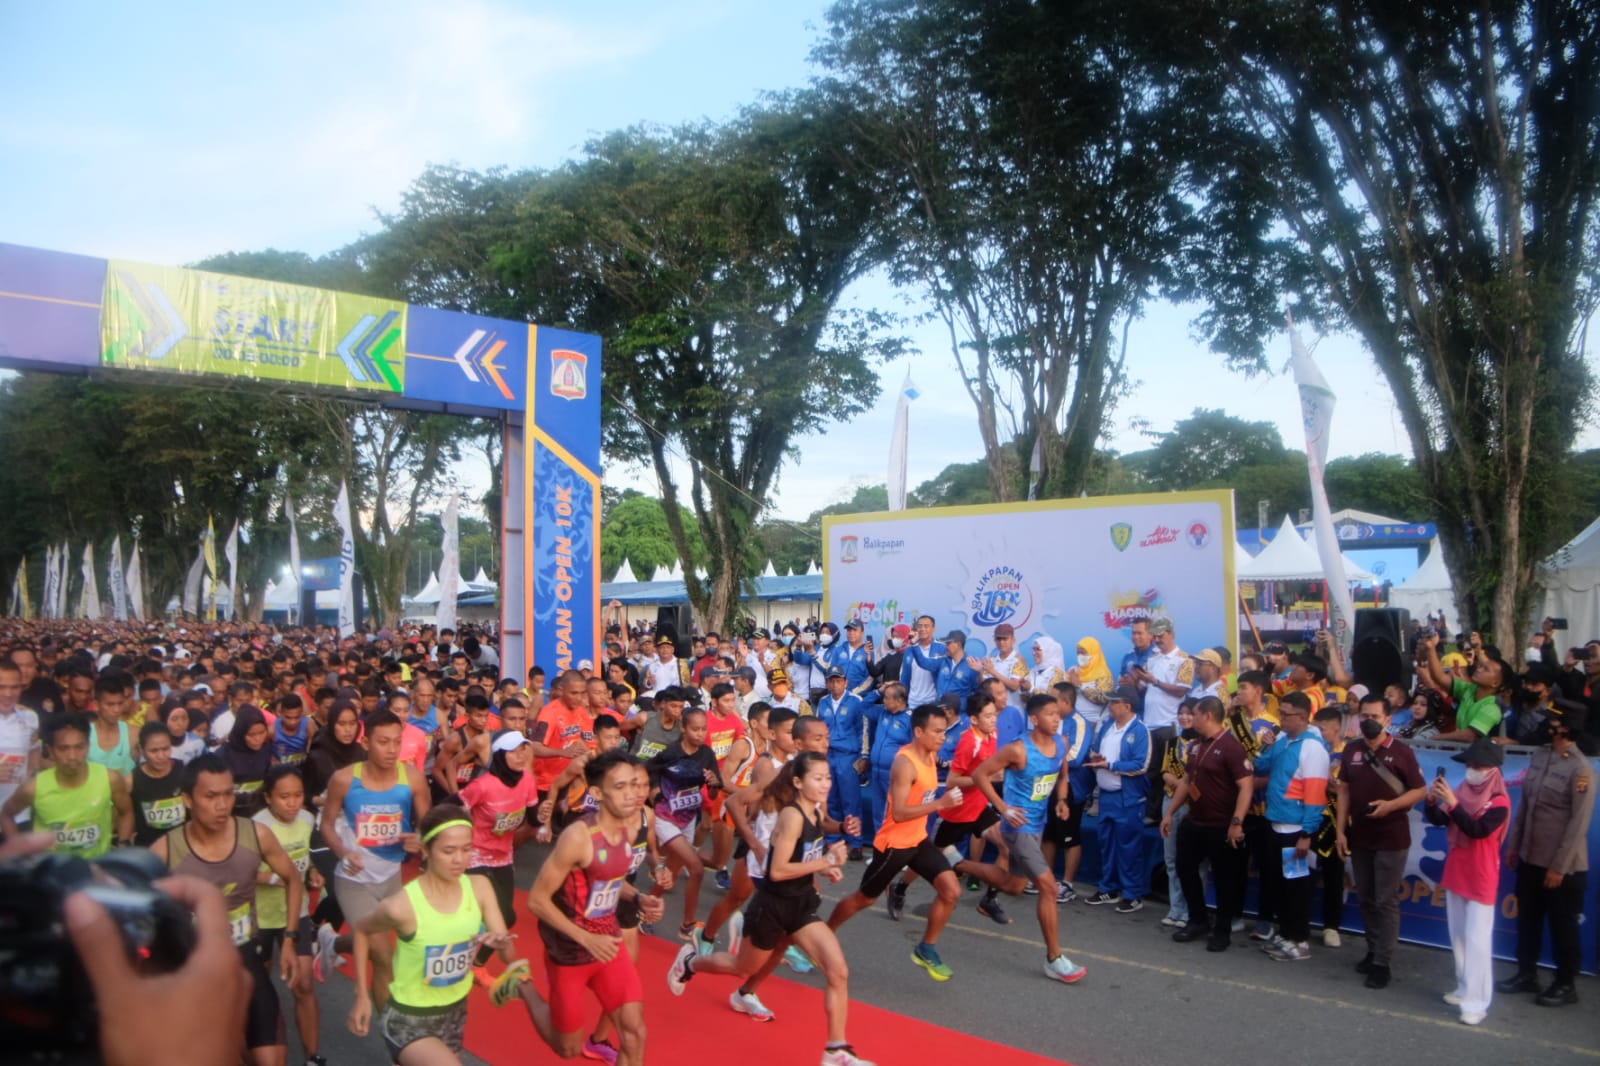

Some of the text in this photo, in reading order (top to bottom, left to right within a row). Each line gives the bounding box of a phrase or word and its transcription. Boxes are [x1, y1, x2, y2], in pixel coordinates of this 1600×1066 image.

[863, 536, 905, 550] Balikpapan
[556, 484, 573, 678] APAN OPEN 10K
[971, 565, 1023, 611] BALIKPAPAN
[997, 583, 1020, 591] OPEN
[672, 796, 698, 807] 1333
[147, 807, 181, 821] 0721
[56, 826, 96, 843] 0478
[363, 824, 397, 837] 1303
[1398, 879, 1448, 908] OPE
